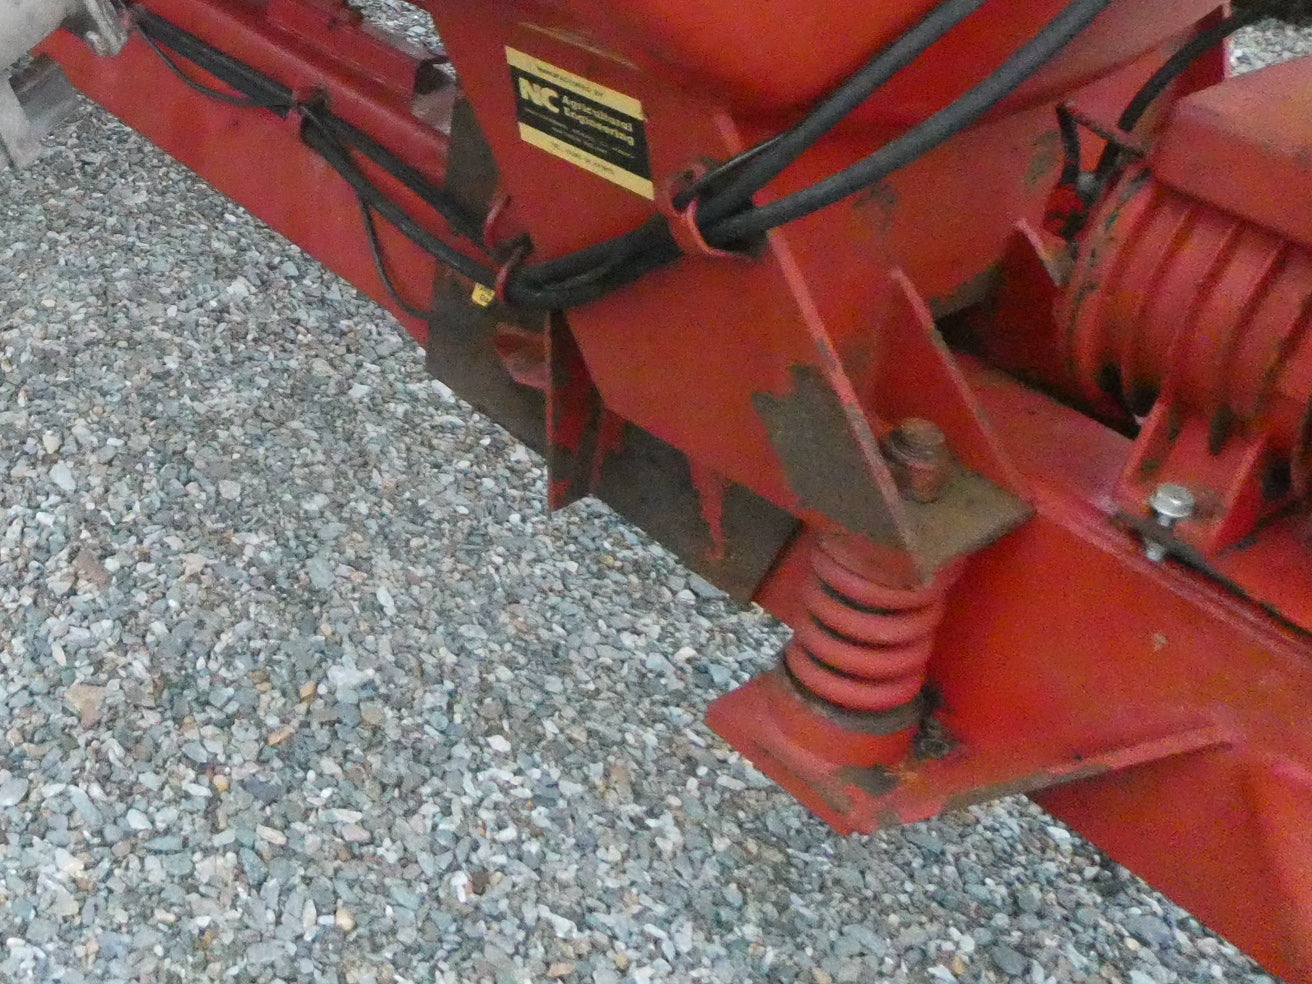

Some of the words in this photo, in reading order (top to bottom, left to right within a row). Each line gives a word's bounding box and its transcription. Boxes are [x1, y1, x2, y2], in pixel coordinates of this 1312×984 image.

[518, 76, 561, 114] NC
[562, 94, 634, 133] Agricultural
[563, 106, 635, 147] Engineering
